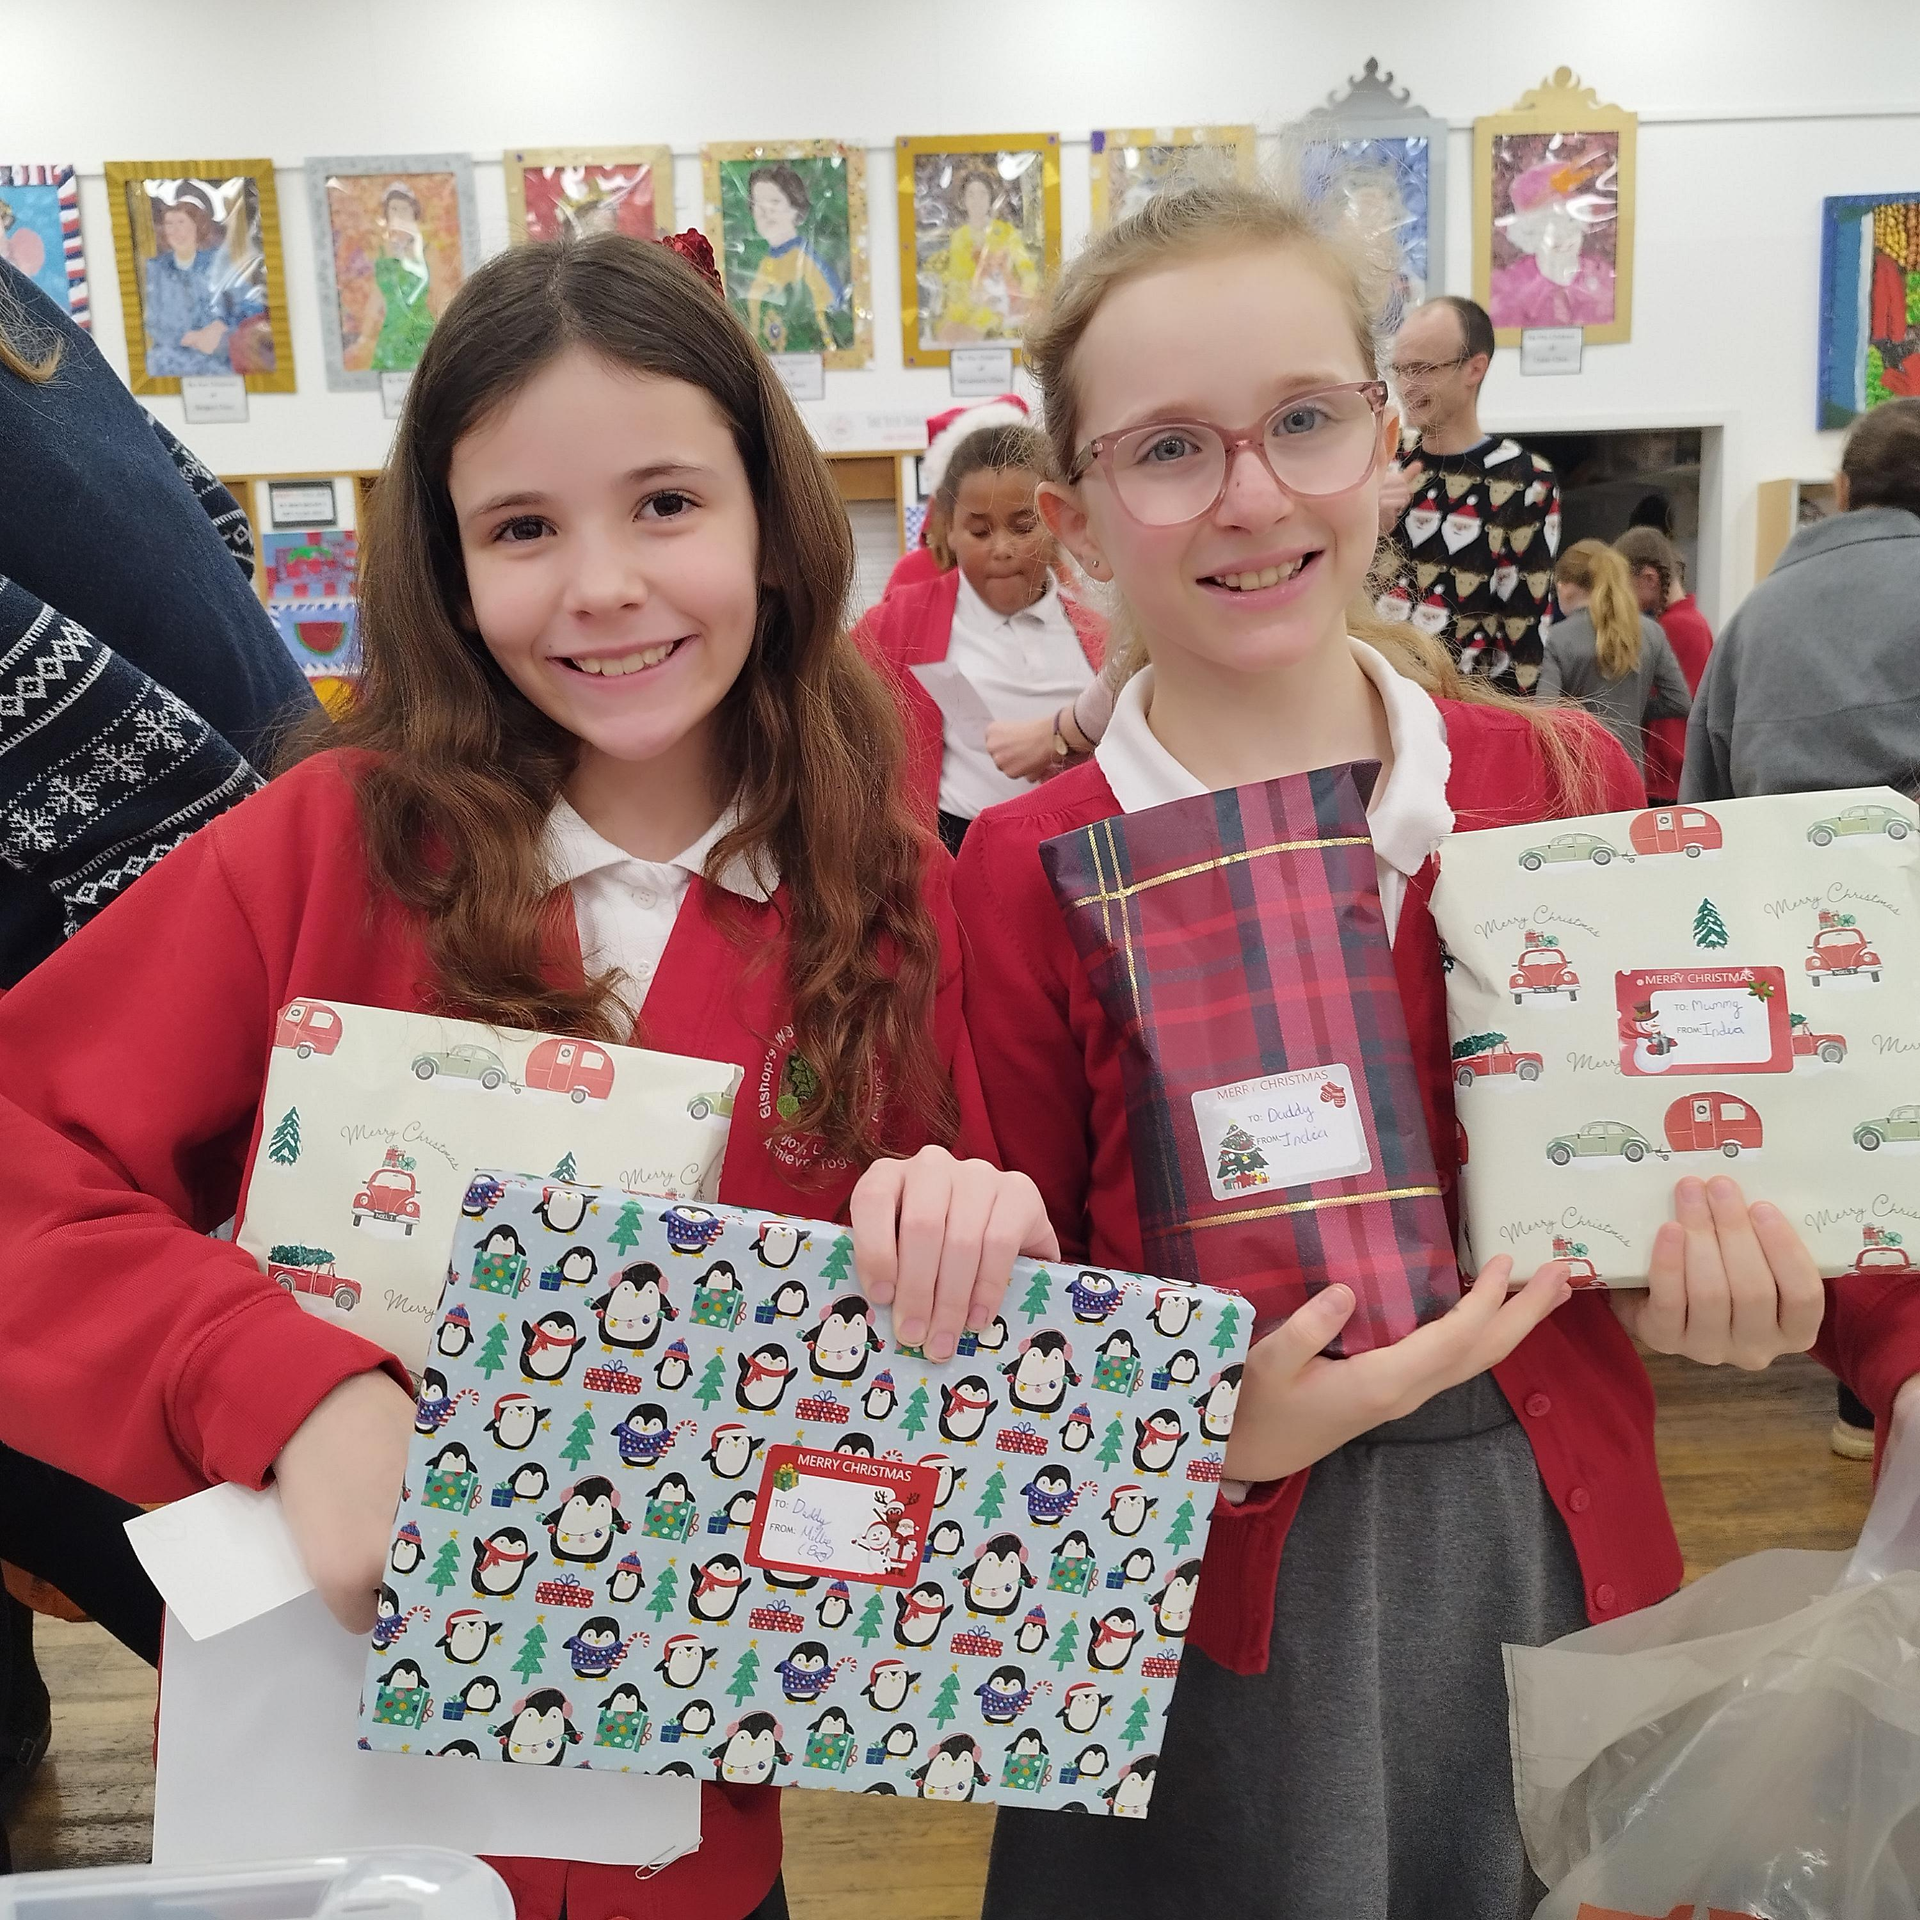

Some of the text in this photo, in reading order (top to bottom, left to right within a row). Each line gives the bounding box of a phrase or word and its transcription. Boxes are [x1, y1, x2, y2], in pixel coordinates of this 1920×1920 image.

[1763, 882, 1900, 919] Merry Christmas
[1474, 905, 1600, 939] Merry Christmas
[1645, 972, 1755, 985] MERRY CHRISTMAS
[1674, 1003, 1689, 1011] TO:
[1677, 1020, 1745, 1037] FROM: India
[1259, 1069, 1329, 1092] CHRISTMAS
[1248, 1114, 1264, 1123] TO:
[340, 1120, 459, 1171] Merry Christmas
[1279, 1126, 1329, 1147] India
[619, 1163, 675, 1190] Merry
[1499, 1206, 1631, 1248] Merry Christmas
[1803, 1208, 1866, 1234] Merry
[383, 1288, 436, 1324] Merry
[797, 1454, 912, 1482] MERRY CHRISTMAS
[774, 1499, 790, 1509] TO:
[769, 1523, 796, 1534] FROM:
